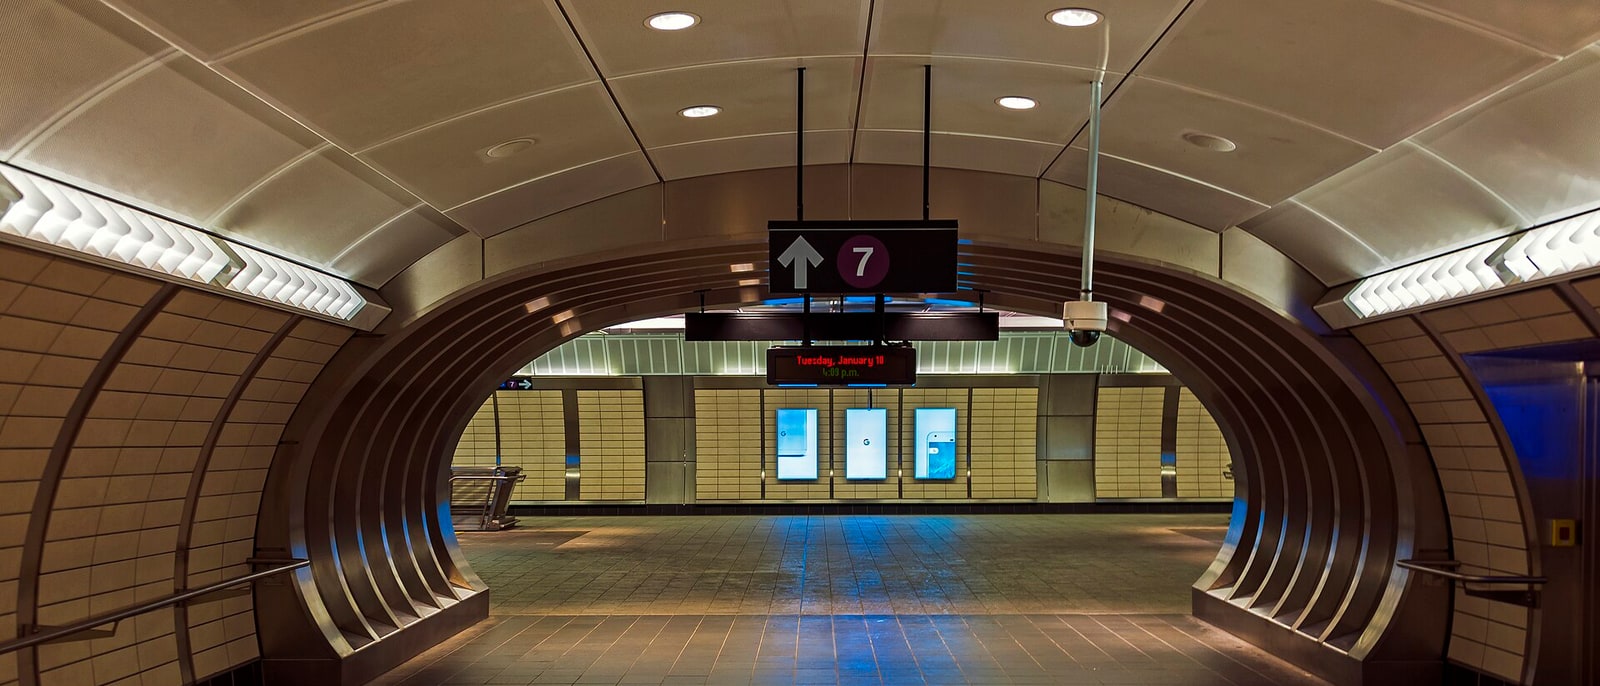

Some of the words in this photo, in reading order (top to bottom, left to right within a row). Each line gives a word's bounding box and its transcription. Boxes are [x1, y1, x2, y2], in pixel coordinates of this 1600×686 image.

[853, 247, 874, 277] 7
[797, 355, 836, 367] Tuesday,
[838, 355, 874, 367] January
[841, 368, 860, 379] p.m.
[863, 438, 870, 446] G
